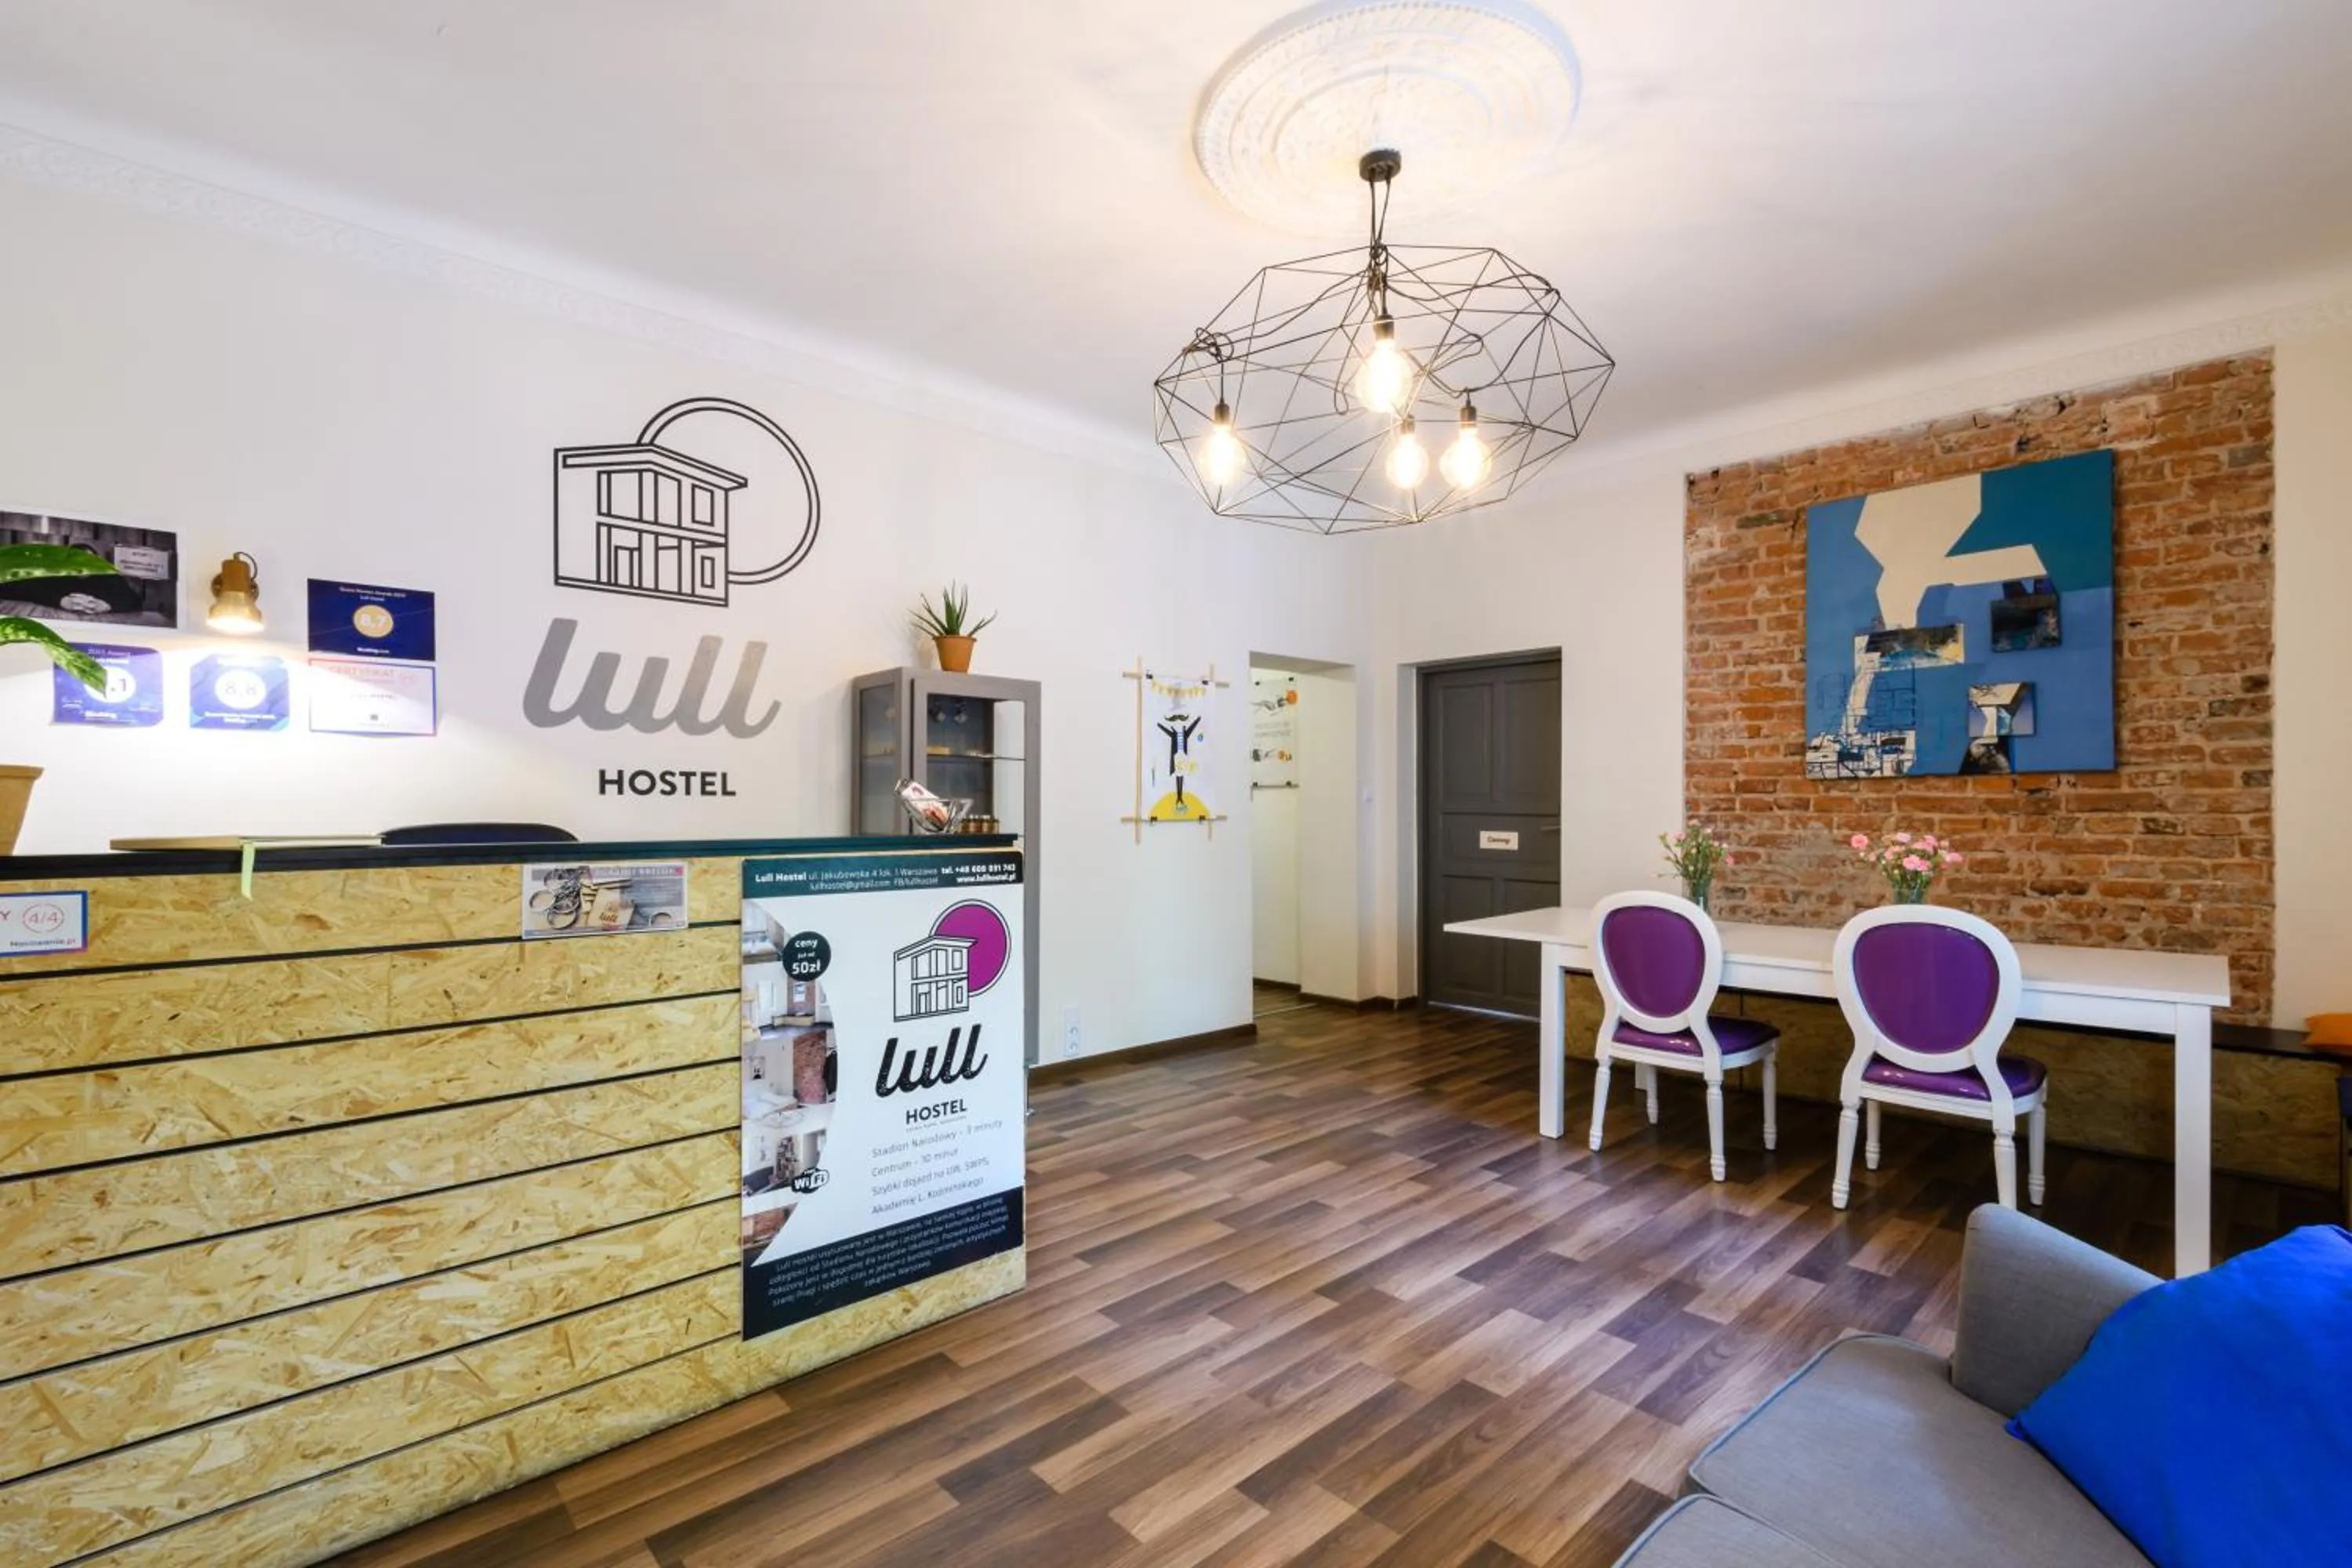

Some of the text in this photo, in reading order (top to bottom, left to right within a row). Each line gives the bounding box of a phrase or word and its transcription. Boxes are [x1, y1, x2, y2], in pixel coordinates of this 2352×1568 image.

[523, 618, 782, 739] lull
[599, 769, 736, 797] HOSTEL
[755, 873, 773, 882] Lull
[775, 872, 806, 881] Hostel
[794, 938, 818, 949] ceny
[875, 1023, 988, 1098] lull
[906, 1098, 967, 1125] HOSTEL
